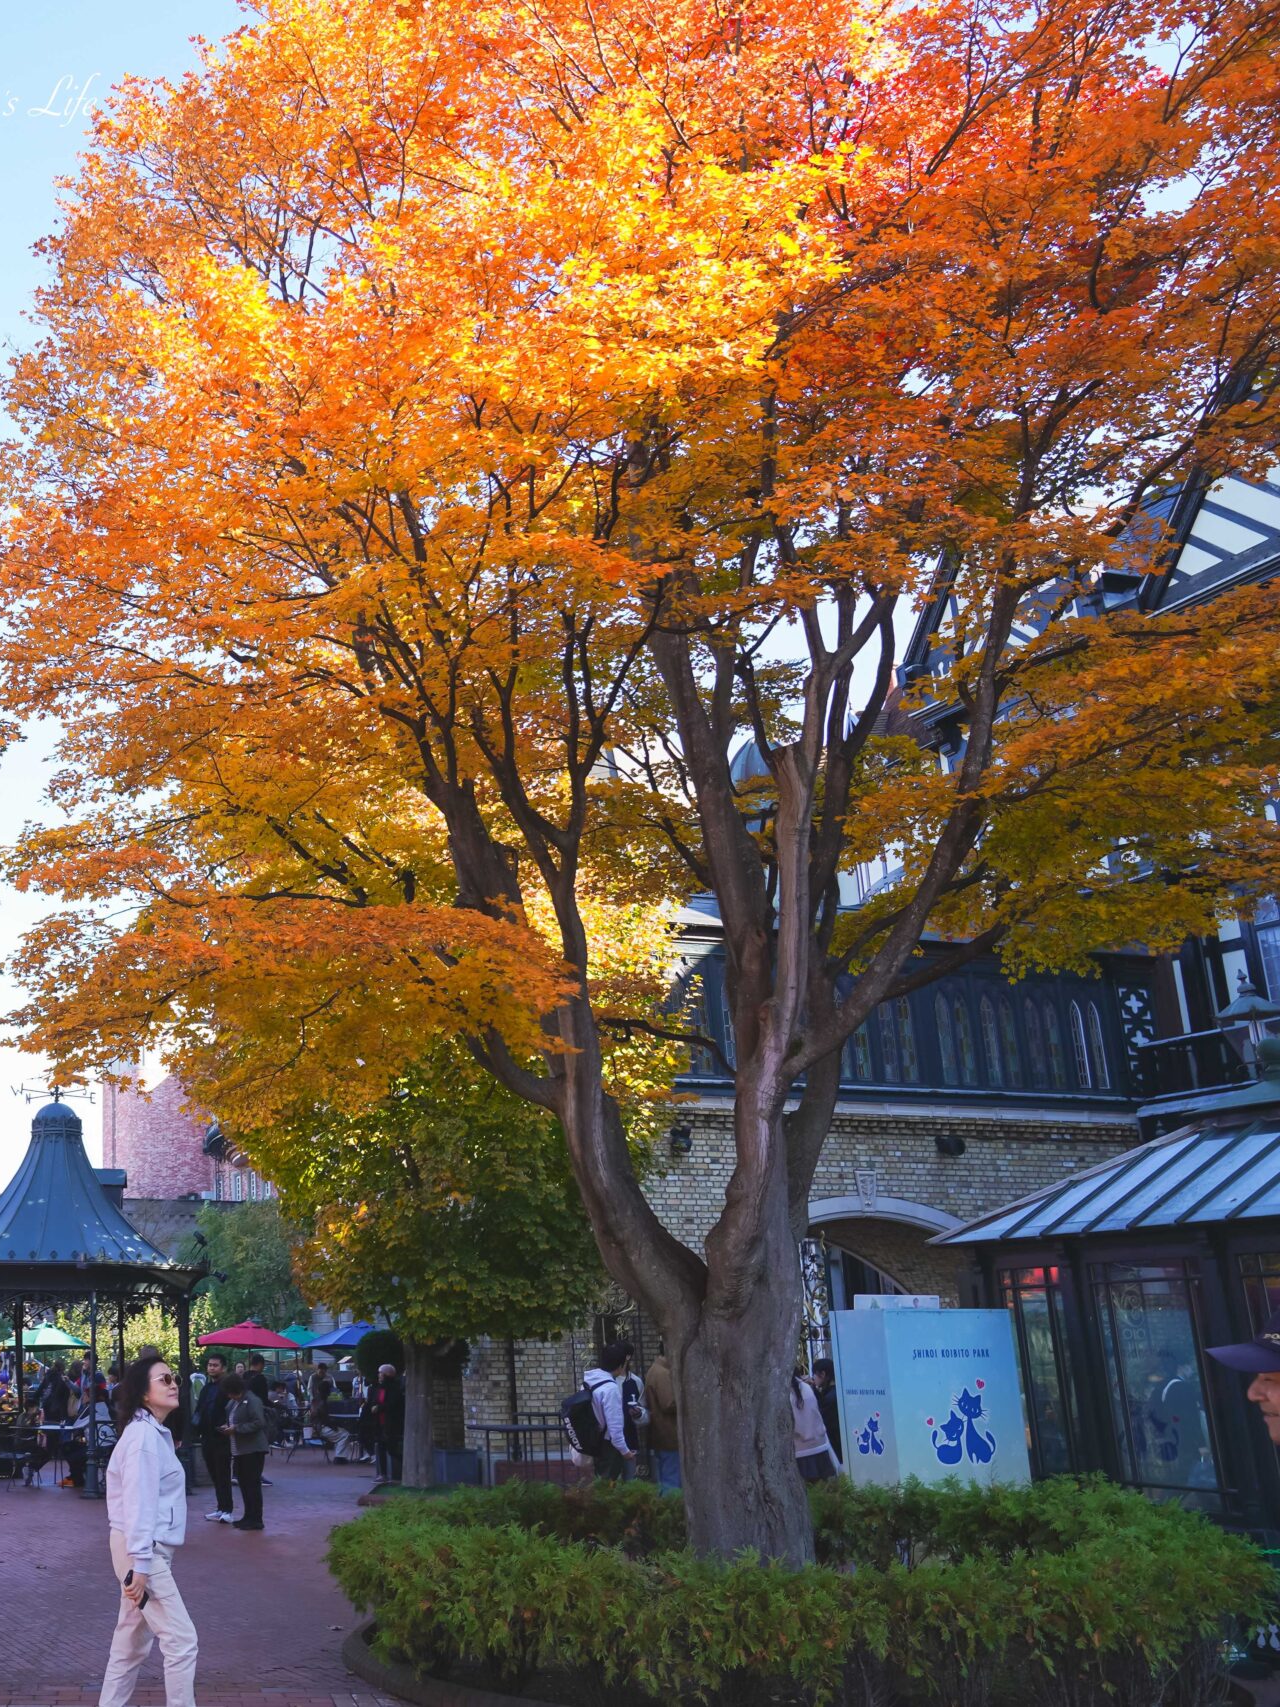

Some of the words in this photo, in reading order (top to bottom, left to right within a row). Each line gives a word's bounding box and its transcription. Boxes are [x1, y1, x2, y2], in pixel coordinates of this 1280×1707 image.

[912, 1348, 938, 1359] SHIROI
[941, 1348, 970, 1358] KOIBITO
[972, 1348, 990, 1358] PARK
